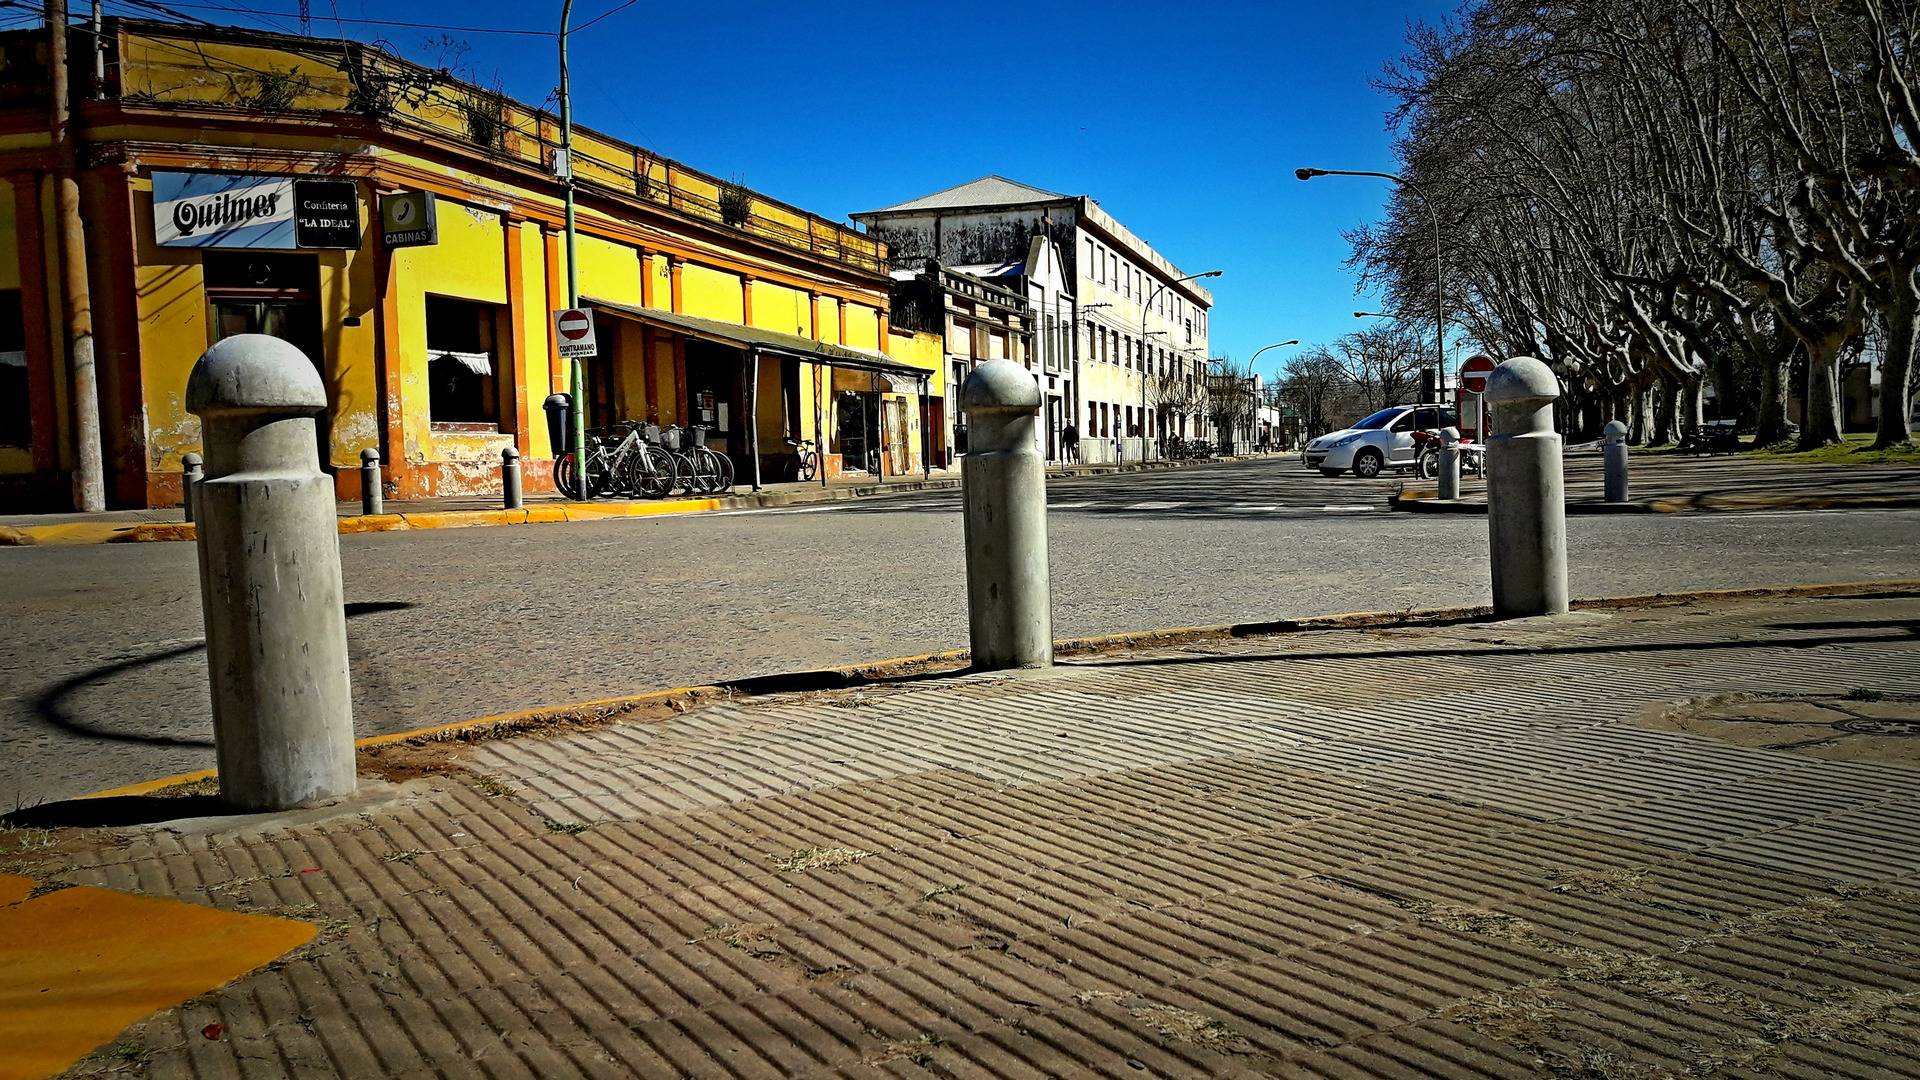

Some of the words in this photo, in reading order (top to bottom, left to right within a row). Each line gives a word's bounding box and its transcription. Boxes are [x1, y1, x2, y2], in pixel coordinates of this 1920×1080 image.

[173, 193, 276, 237] Quilmes
[385, 231, 427, 244] CABINAS
[560, 343, 594, 353] CONTRAMANO
